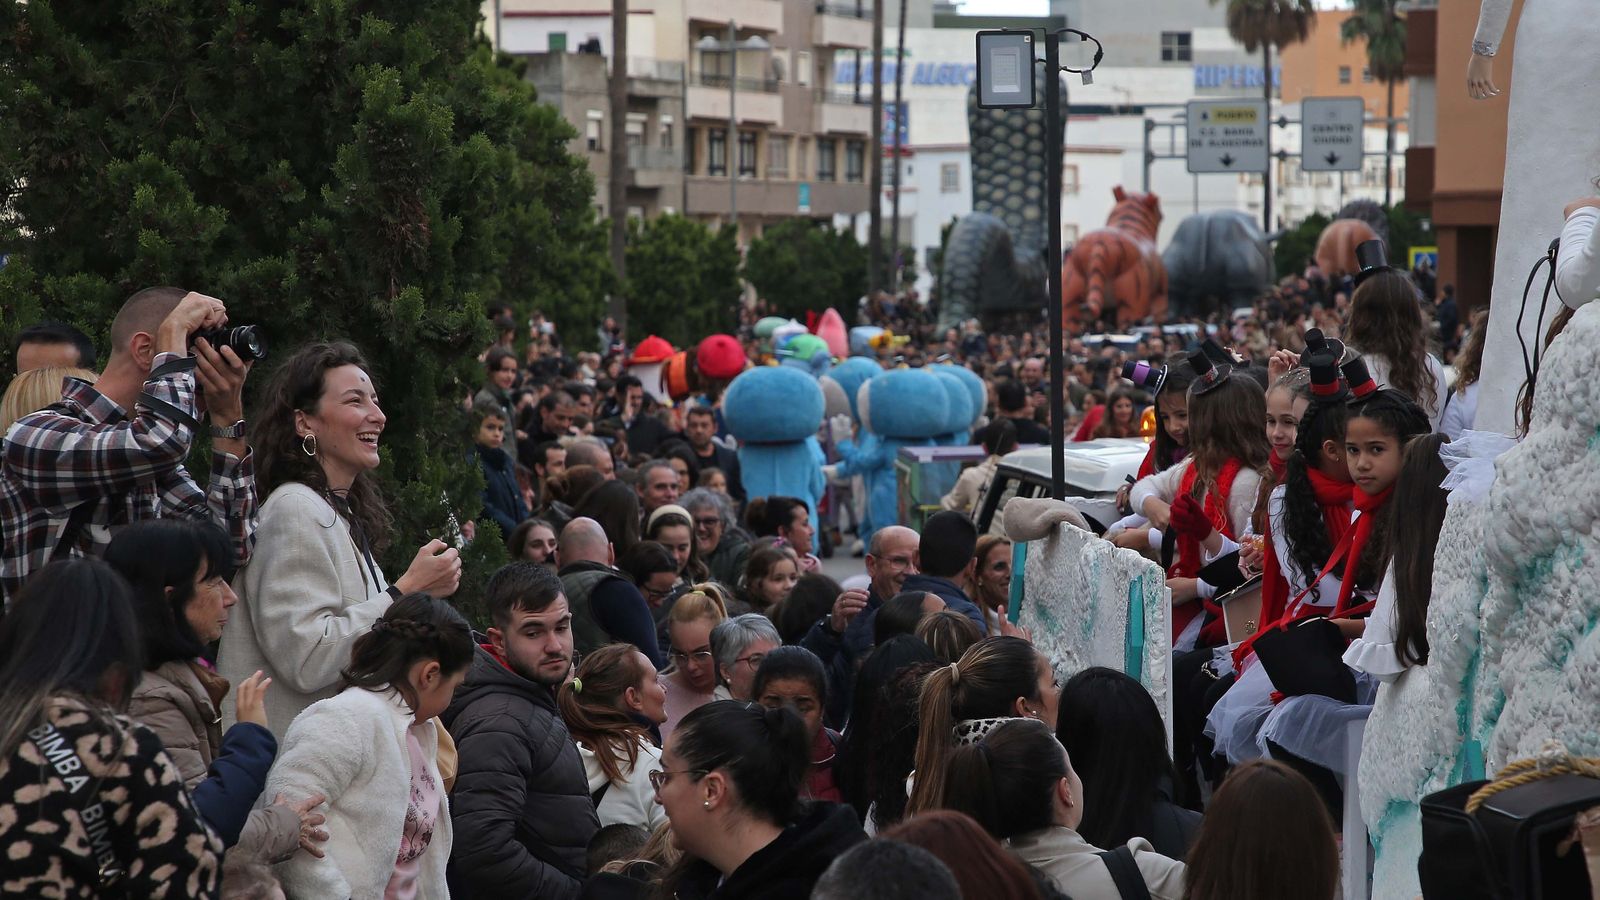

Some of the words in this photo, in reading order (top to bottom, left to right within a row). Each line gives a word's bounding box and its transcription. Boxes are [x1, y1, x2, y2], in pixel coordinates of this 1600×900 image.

[1215, 110, 1257, 119] PUERTO
[1311, 123, 1354, 134] CENTRO
[1190, 139, 1203, 148] DE
[1208, 139, 1264, 148] ALGECIRAS
[1312, 137, 1353, 146] CIUDAD
[27, 723, 90, 794] BIMBA
